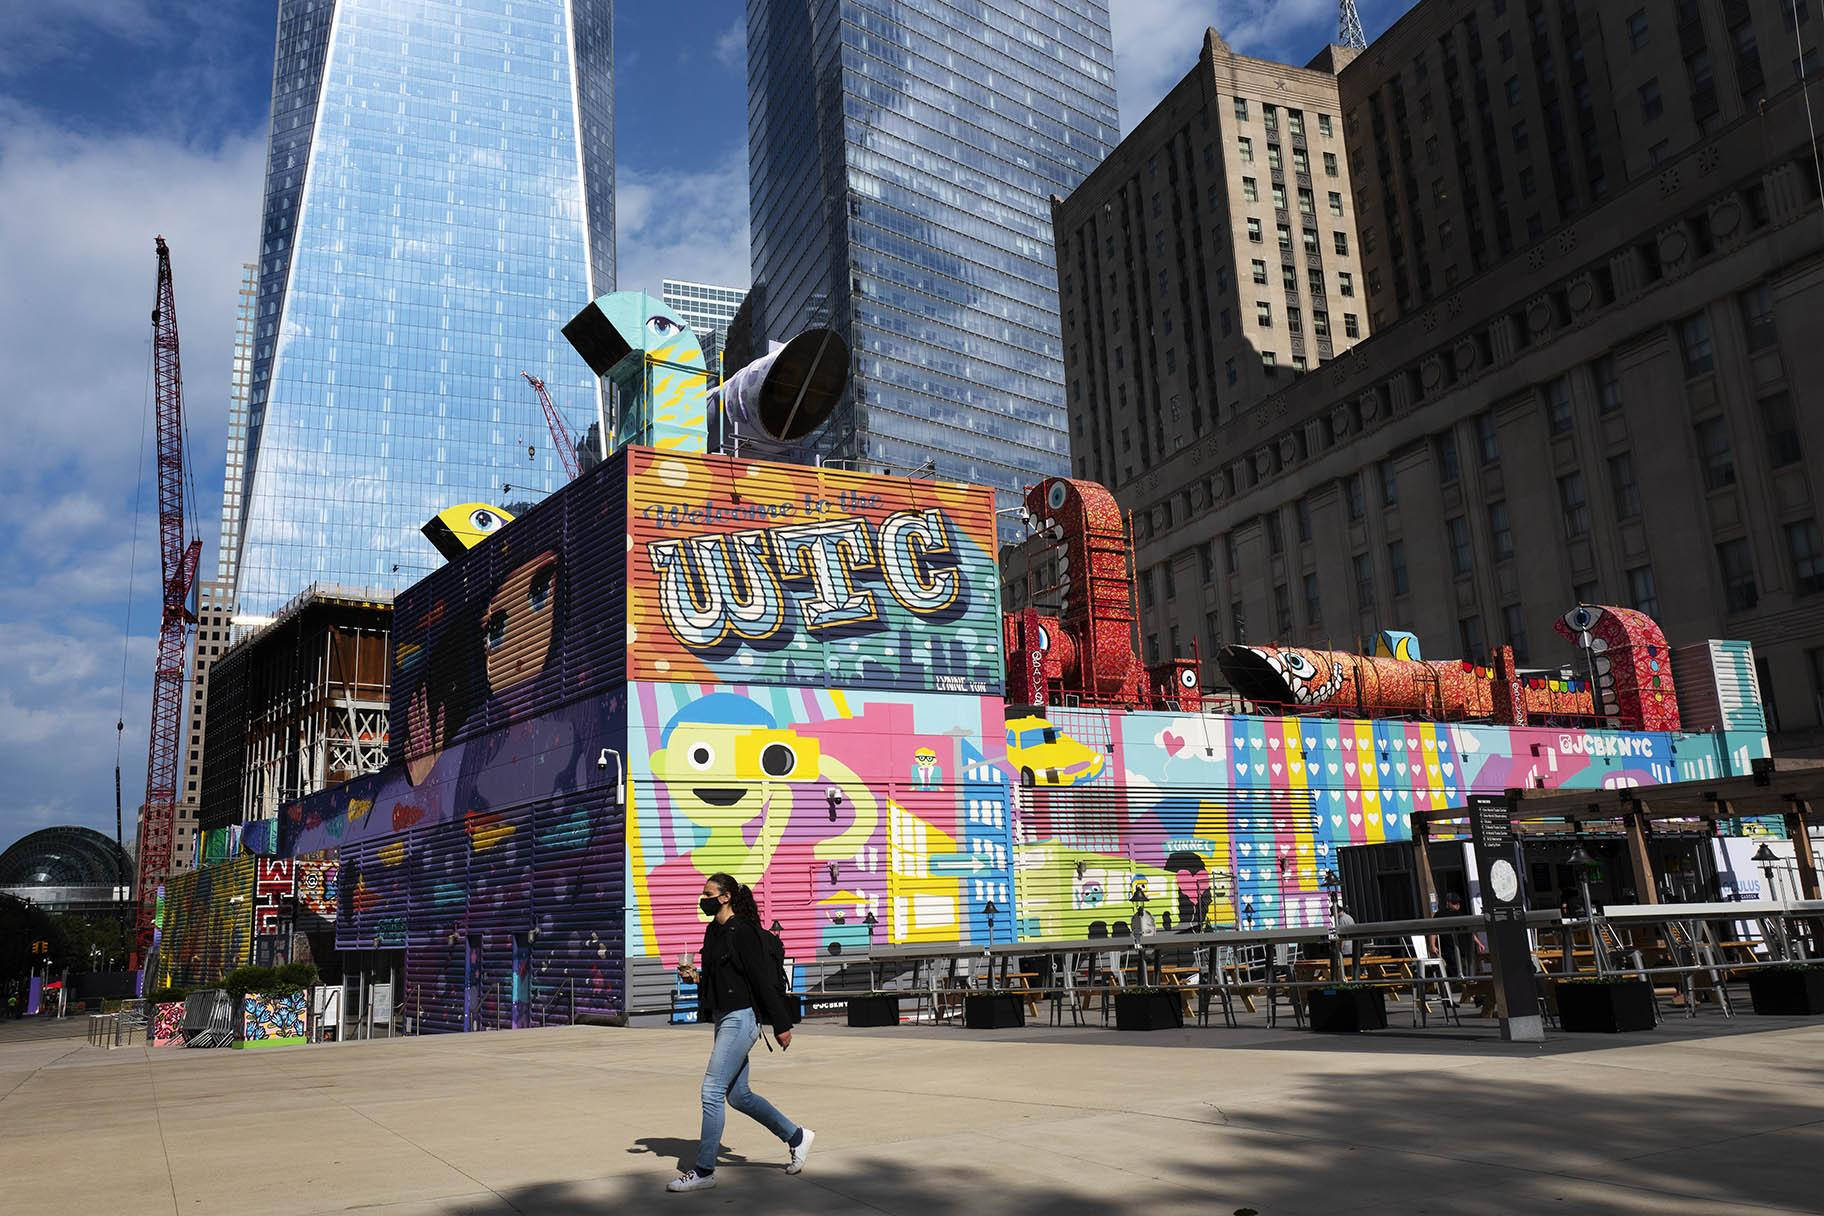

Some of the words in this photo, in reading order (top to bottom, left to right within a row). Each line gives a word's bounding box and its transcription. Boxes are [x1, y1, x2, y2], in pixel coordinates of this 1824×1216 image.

[643, 500, 797, 529] Welcome
[805, 493, 831, 515] to
[840, 489, 883, 512] the
[648, 508, 959, 648] WTC
[936, 675, 968, 691] LYNNE
[1167, 840, 1213, 852] TUNNEL
[1721, 880, 1760, 893] OCULUS
